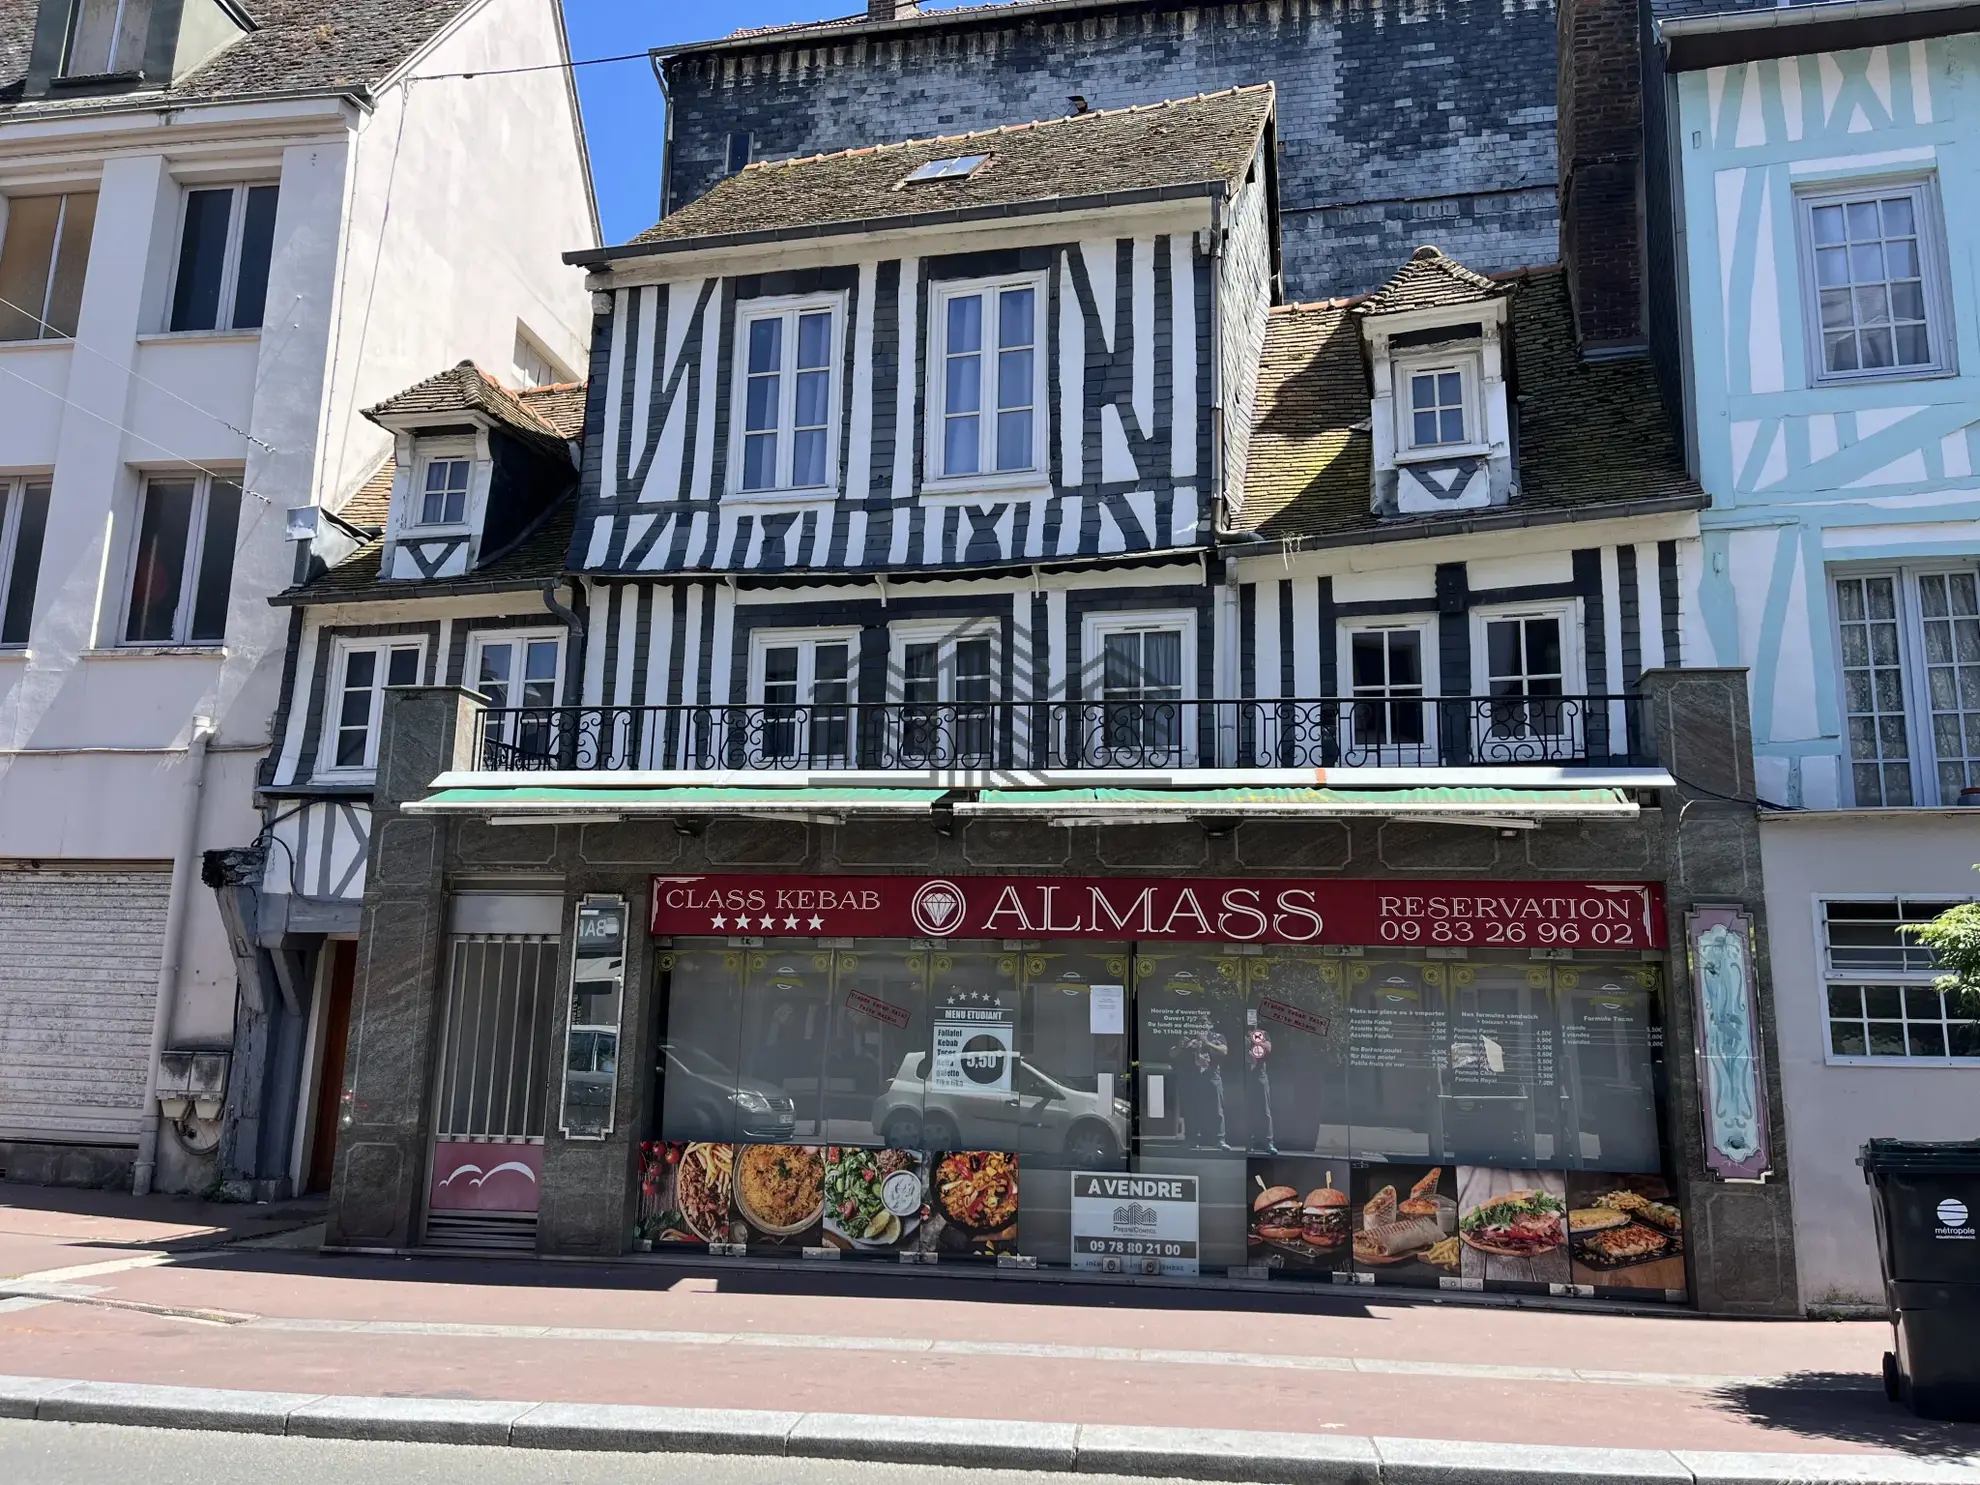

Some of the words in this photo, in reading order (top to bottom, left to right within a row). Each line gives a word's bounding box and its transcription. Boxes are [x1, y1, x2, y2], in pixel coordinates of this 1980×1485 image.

[666, 889, 766, 910] CLASS
[776, 890, 880, 910] KEBAB
[1379, 896, 1630, 919] RESERVATION
[981, 886, 1323, 940] ALMASS
[1380, 921, 1420, 941] 09
[1432, 921, 1474, 942] 83
[1486, 922, 1527, 942] 26
[1538, 922, 1580, 943] 96
[1592, 924, 1634, 944] 02
[945, 1010, 966, 1019] MENU
[968, 1011, 1002, 1020] ETUDIANT
[1088, 1179, 1102, 1195] A
[1104, 1179, 1183, 1198] VENDRE
[1935, 1227, 1975, 1235] métropole
[1090, 1241, 1105, 1251] 09
[1109, 1241, 1124, 1252] 78
[1127, 1243, 1142, 1253] 80
[1146, 1244, 1161, 1255] 21
[1165, 1245, 1181, 1255] 00
